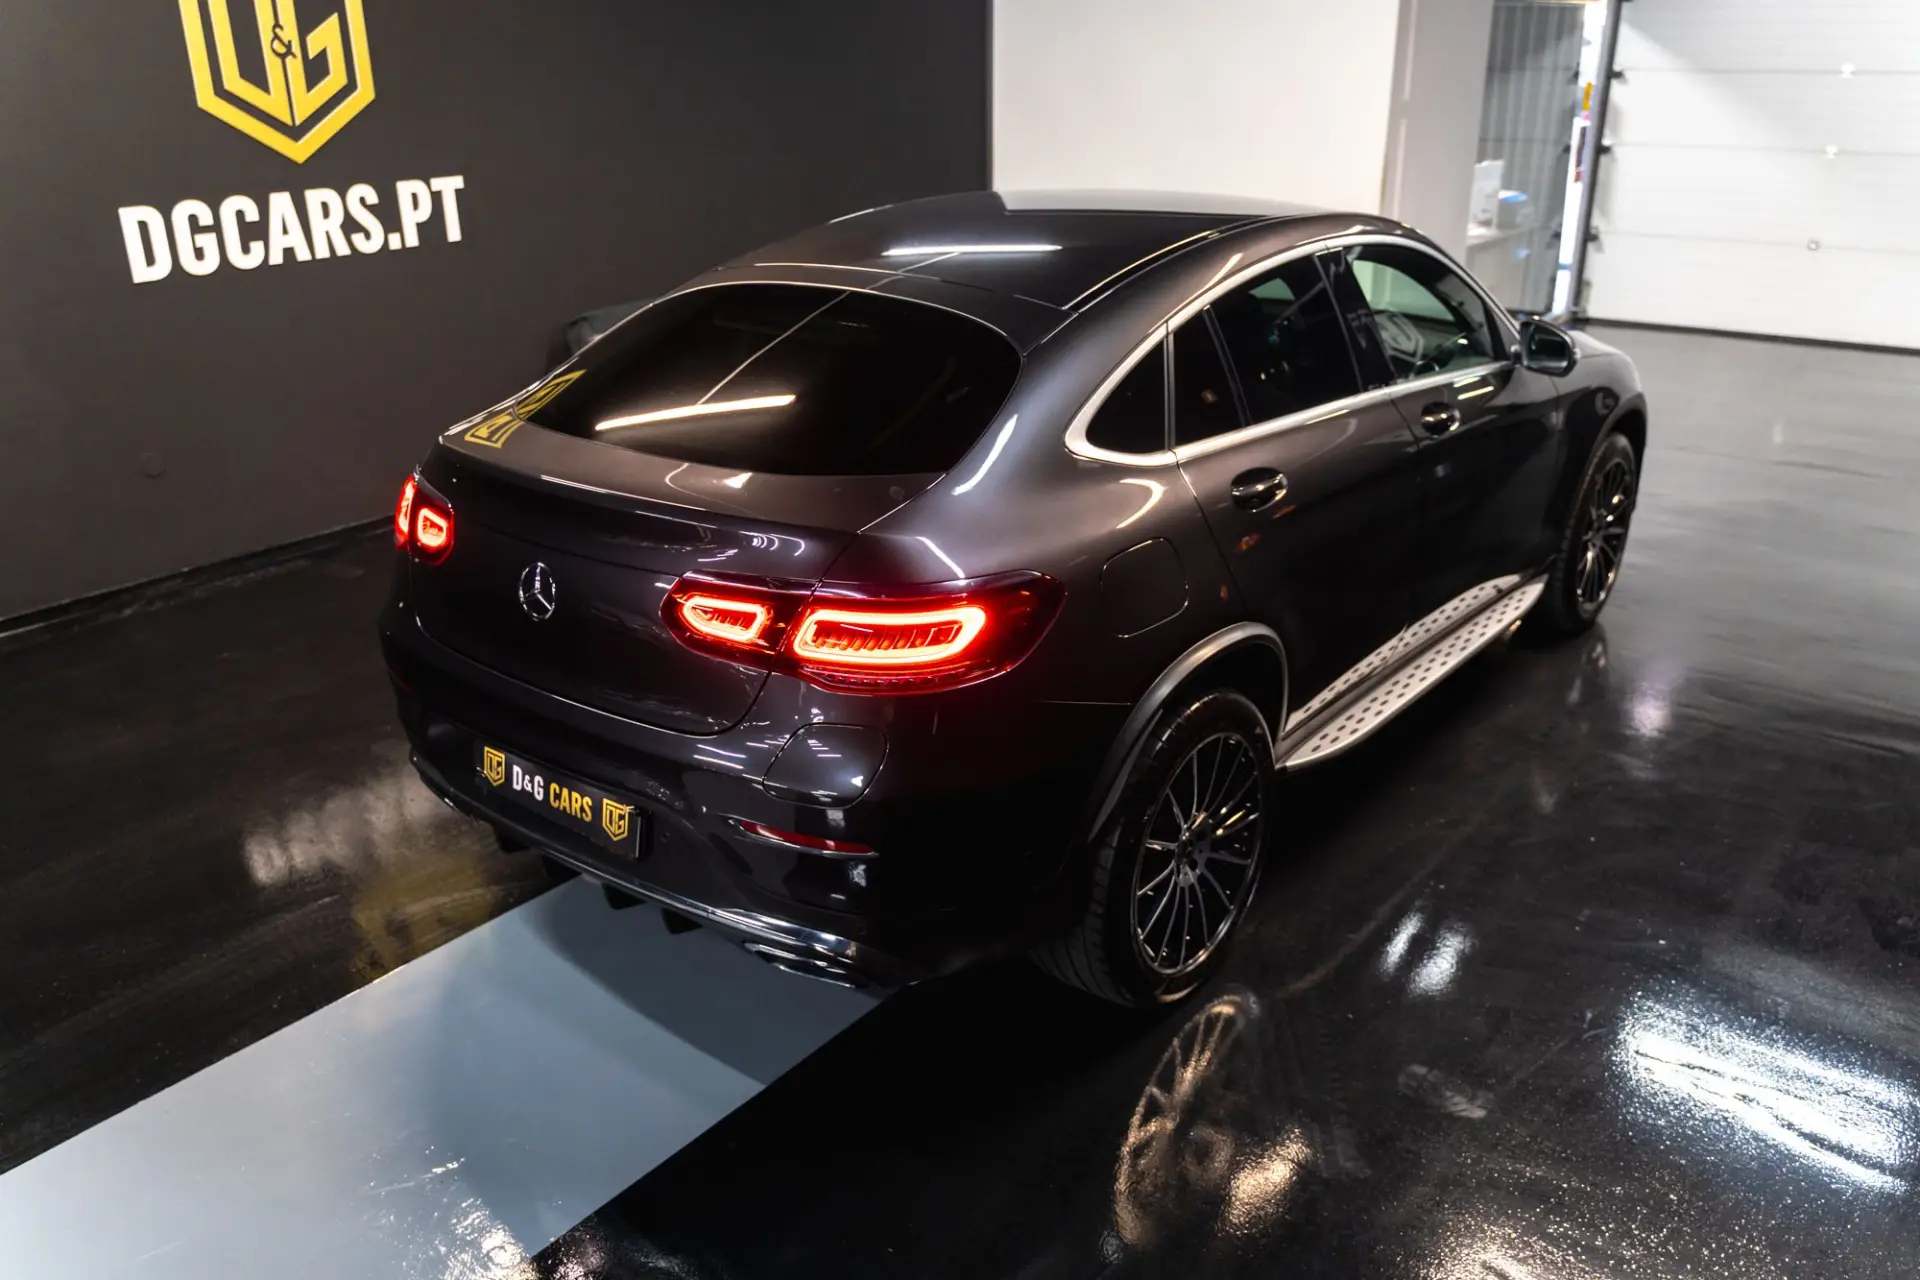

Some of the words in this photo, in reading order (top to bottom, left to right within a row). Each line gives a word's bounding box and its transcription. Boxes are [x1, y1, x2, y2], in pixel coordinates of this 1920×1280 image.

[117, 175, 465, 284] DGCARS.PT
[512, 764, 544, 801] D&G
[549, 782, 593, 822] CARS
